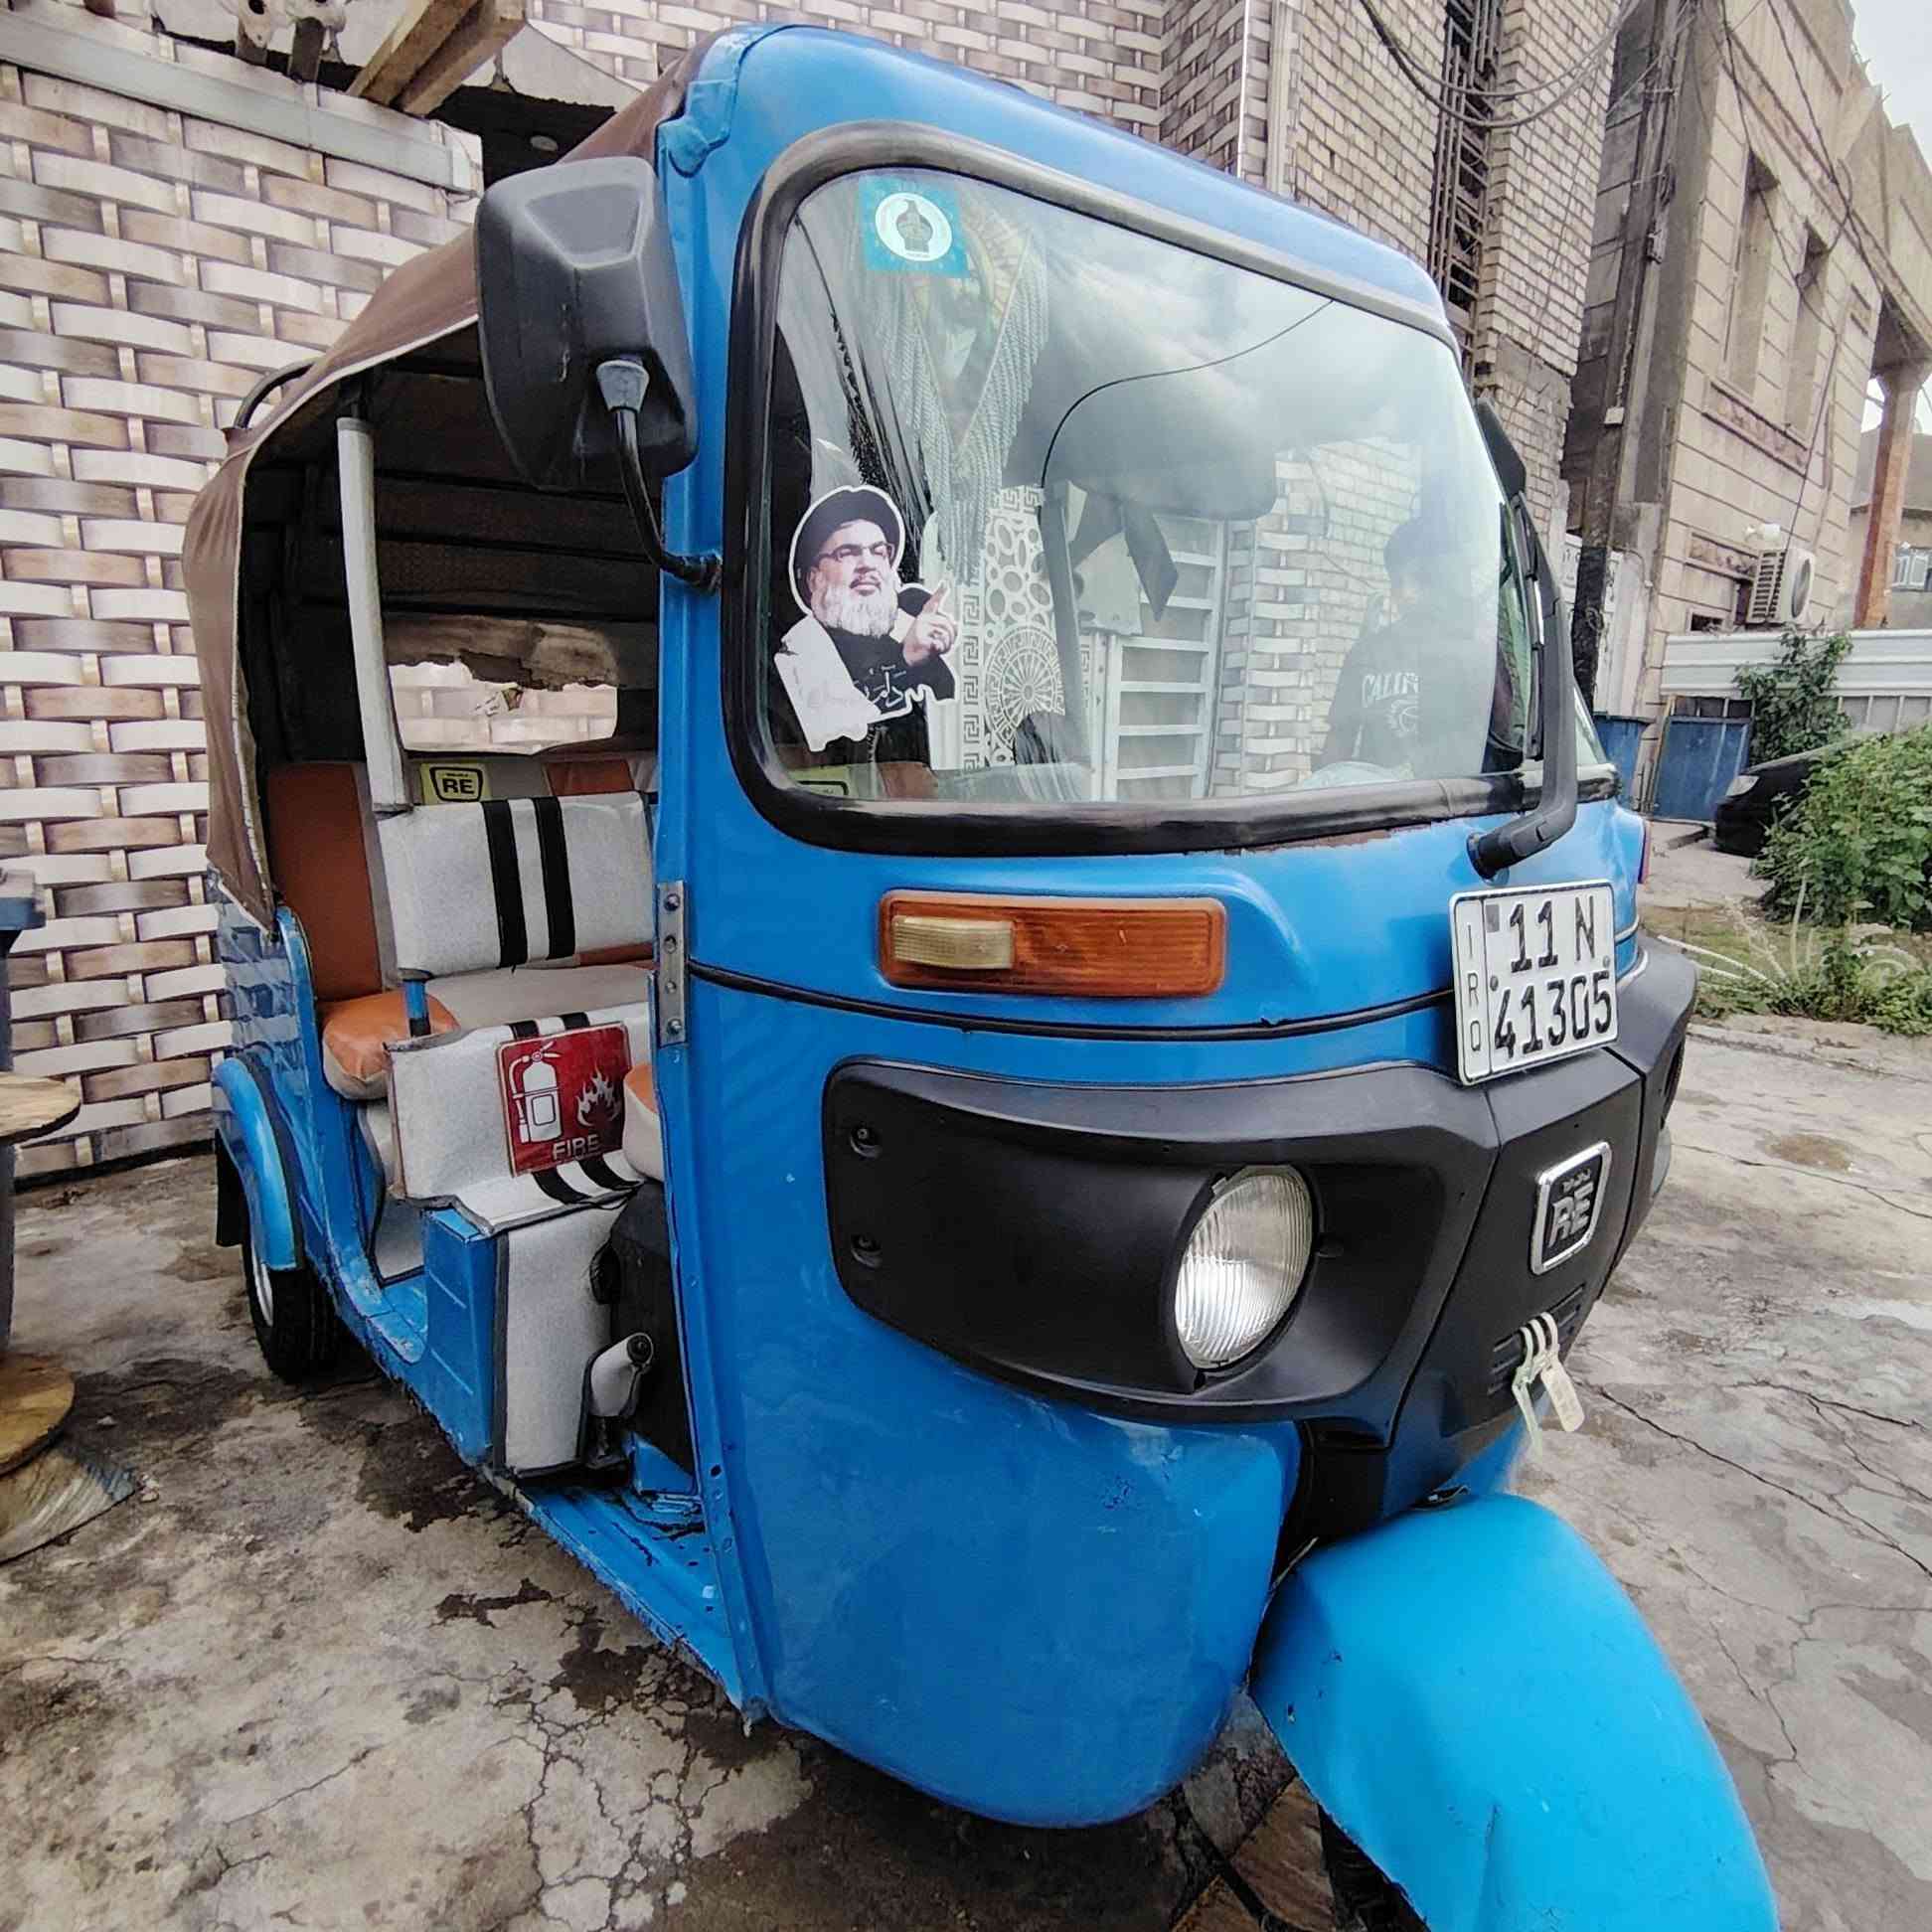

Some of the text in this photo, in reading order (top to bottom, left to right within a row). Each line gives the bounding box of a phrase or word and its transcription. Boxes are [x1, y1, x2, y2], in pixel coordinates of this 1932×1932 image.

[442, 778, 475, 794] RE
[1509, 895, 1595, 973] 11 N
[1494, 970, 1612, 1059] 41305
[552, 1133, 601, 1160] FIRE
[1547, 1181, 1594, 1248] RE
